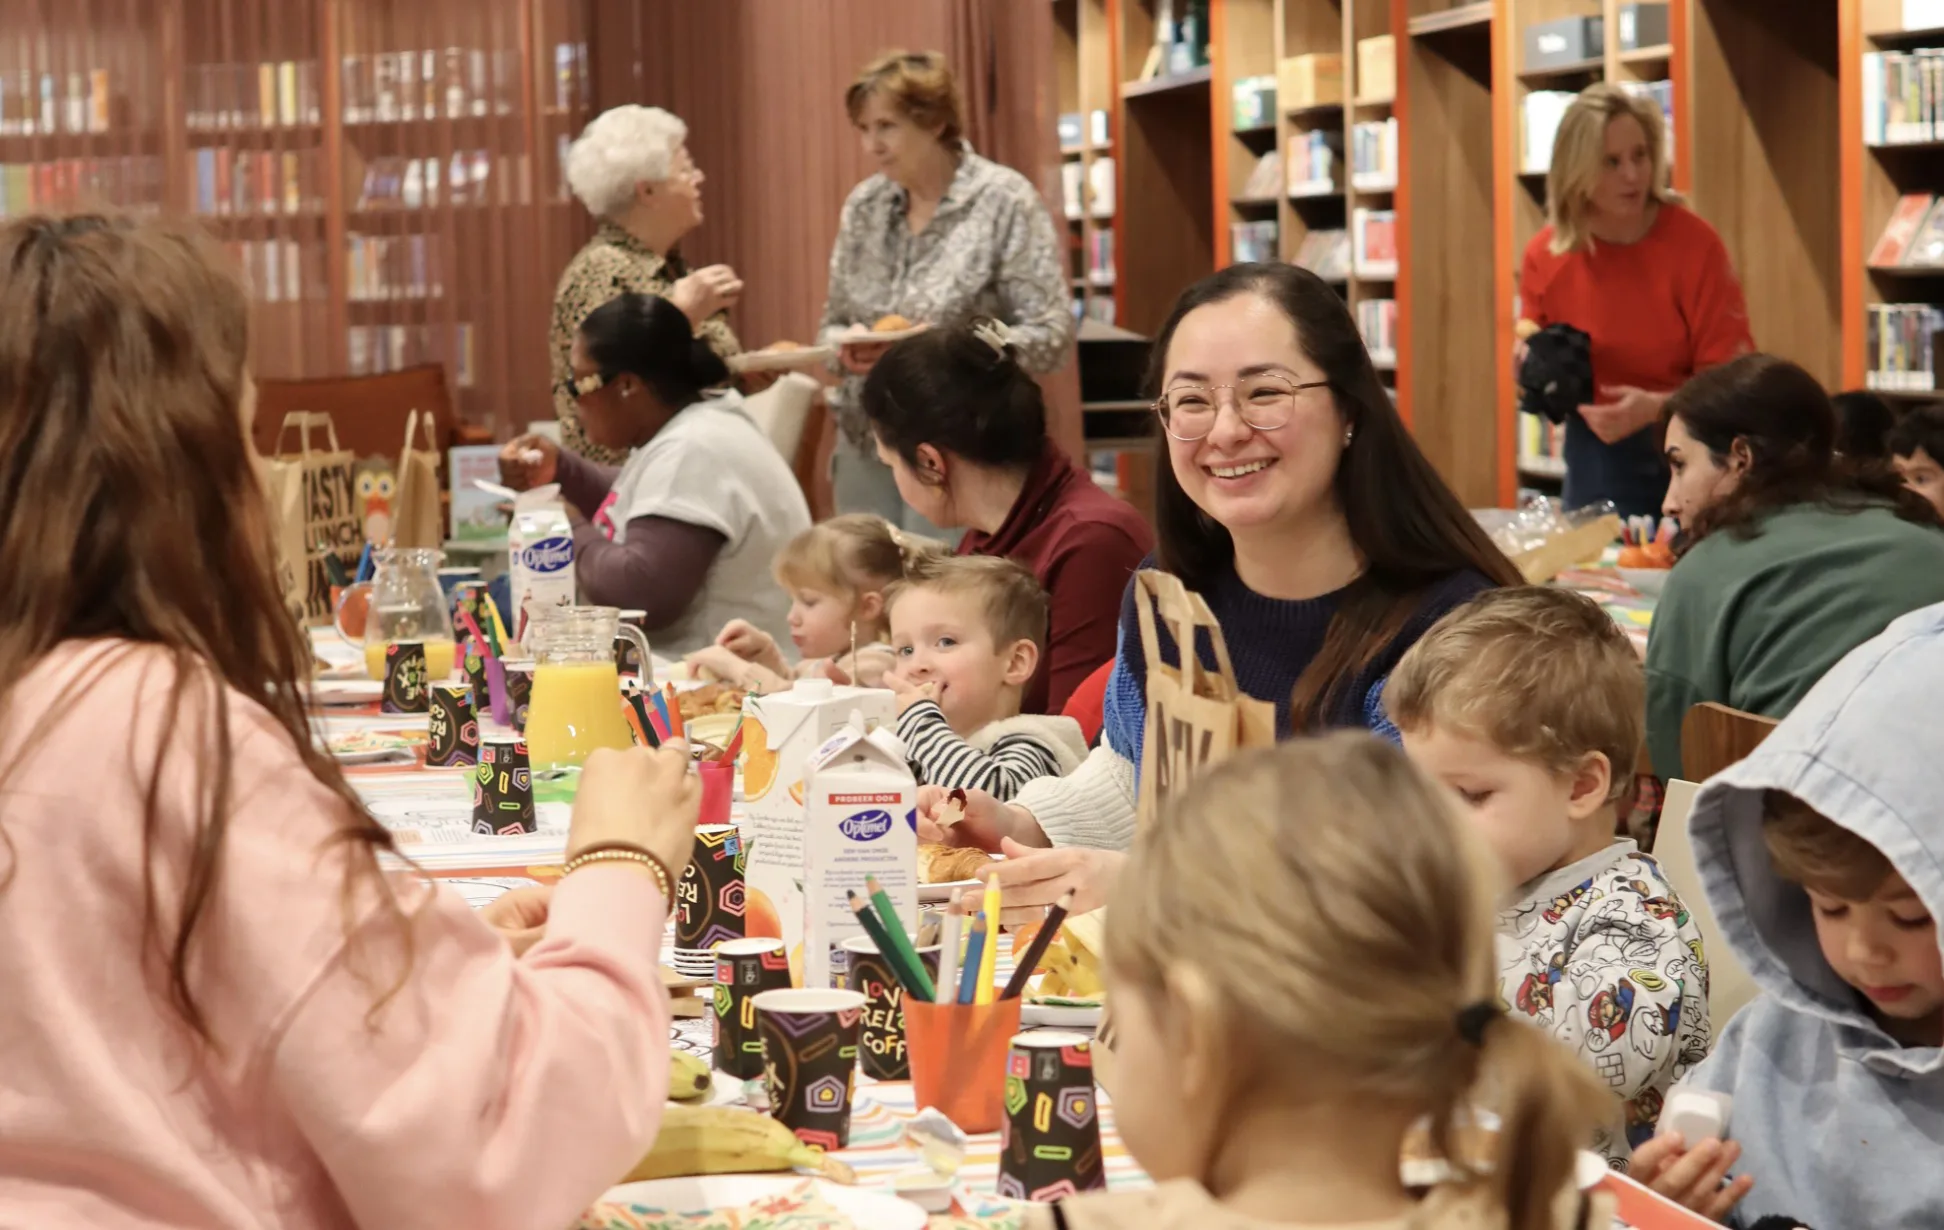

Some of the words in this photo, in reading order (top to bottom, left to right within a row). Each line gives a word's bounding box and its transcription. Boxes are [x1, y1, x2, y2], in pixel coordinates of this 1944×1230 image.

[302, 464, 355, 523] TASTY
[835, 795, 873, 803] PROBEER
[875, 794, 895, 802] OOK
[843, 811, 888, 839] Optimel
[862, 979, 901, 1008] LOV
[859, 1004, 905, 1032] REL
[863, 1031, 907, 1061] COFF
